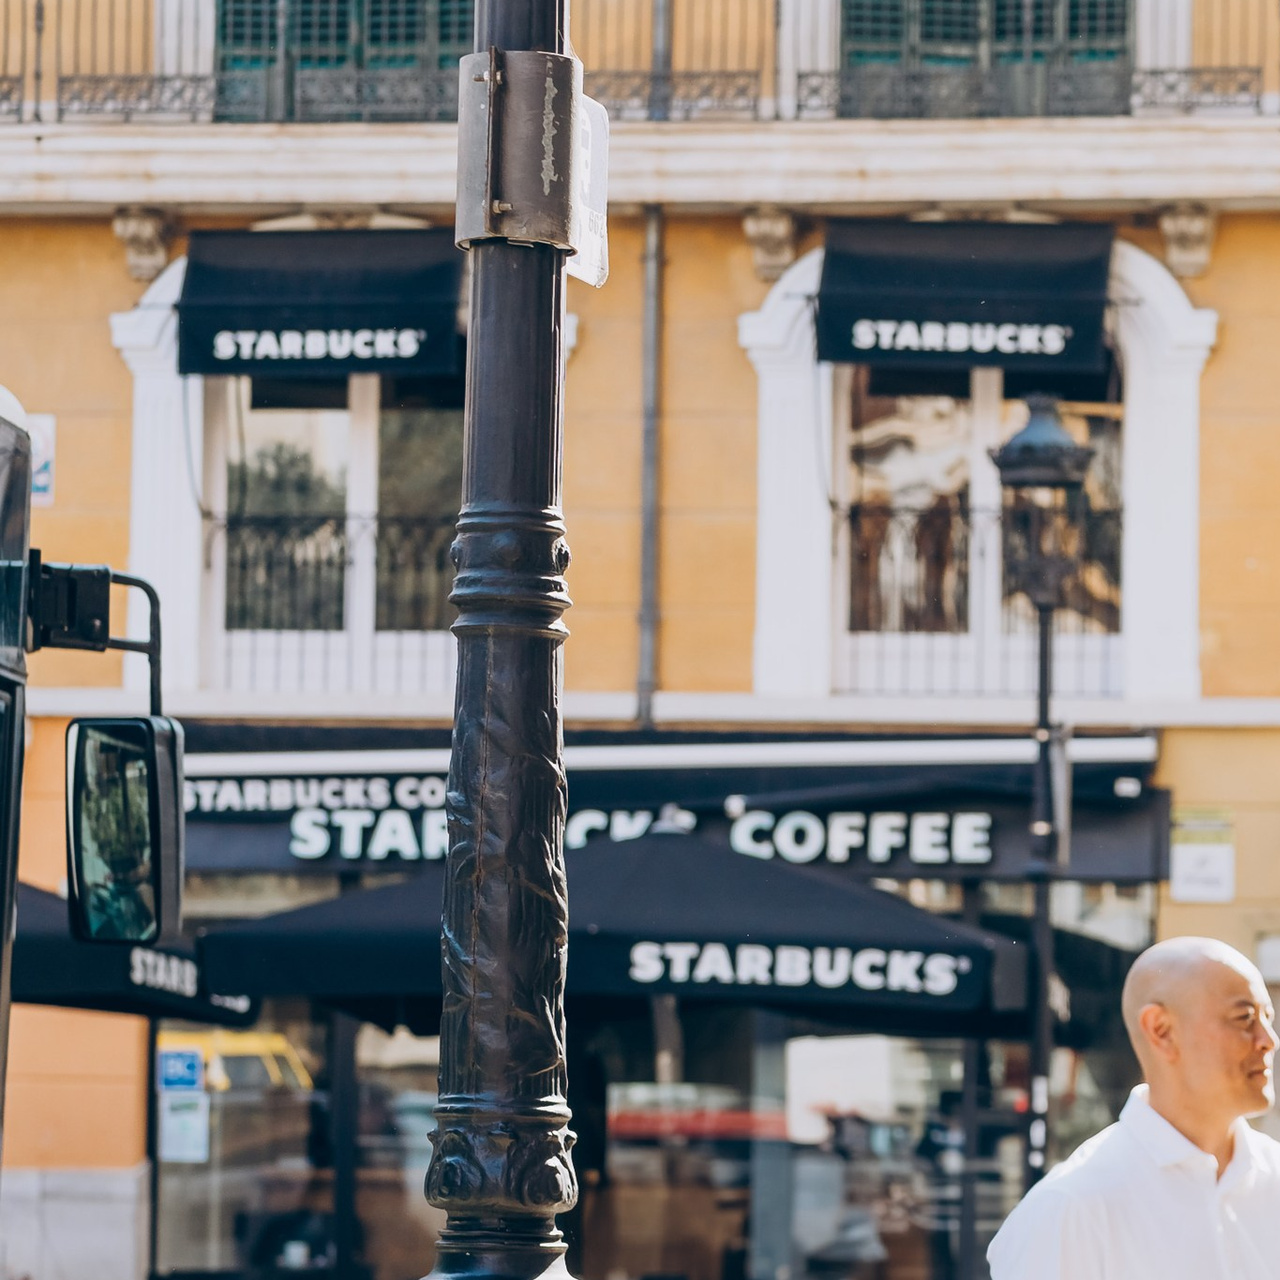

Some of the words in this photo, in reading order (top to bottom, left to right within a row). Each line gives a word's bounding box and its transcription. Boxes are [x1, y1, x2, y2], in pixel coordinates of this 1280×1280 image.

[213, 329, 420, 360] STARBUCKS
[852, 319, 1066, 355] STARBUCKS
[730, 809, 992, 864] COFFEE
[629, 941, 958, 995] STARBUCKS
